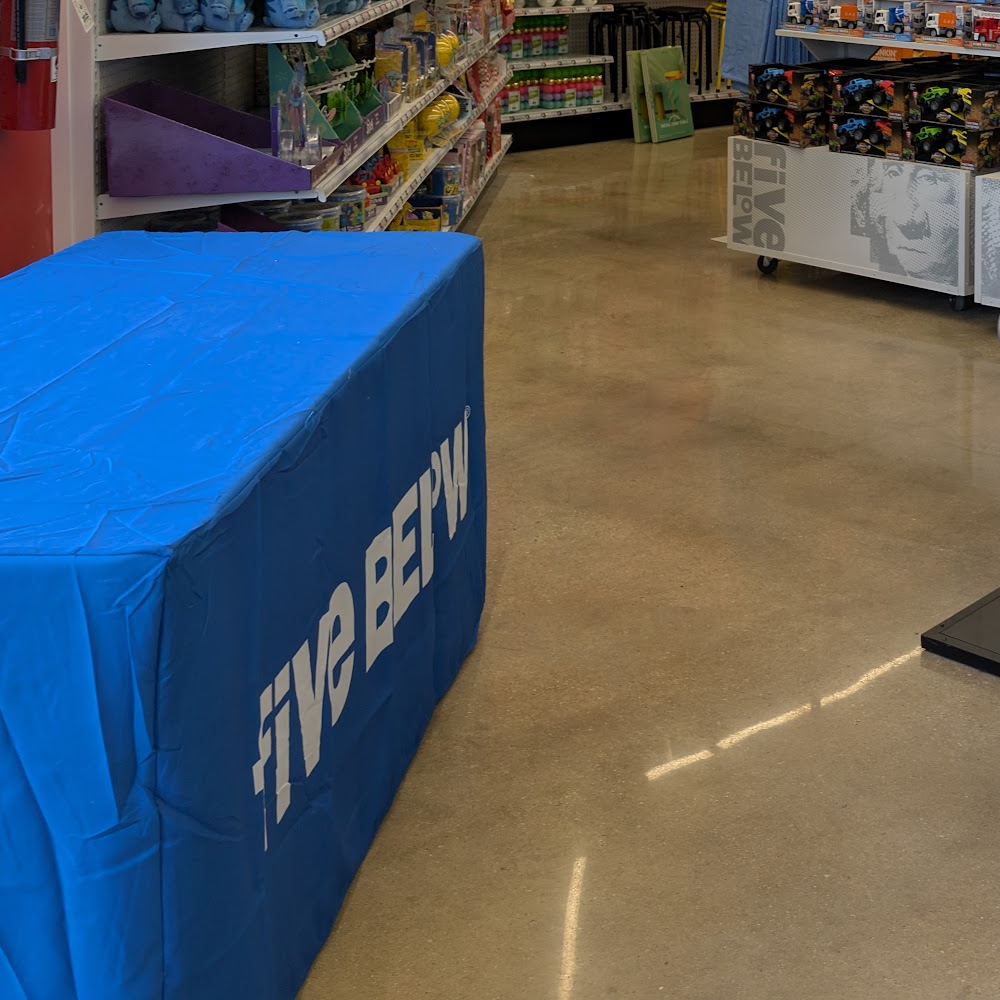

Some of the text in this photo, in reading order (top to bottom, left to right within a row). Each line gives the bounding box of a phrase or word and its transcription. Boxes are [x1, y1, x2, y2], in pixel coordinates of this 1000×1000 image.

[732, 138, 787, 251] five BELOW
[252, 581, 356, 852] five
